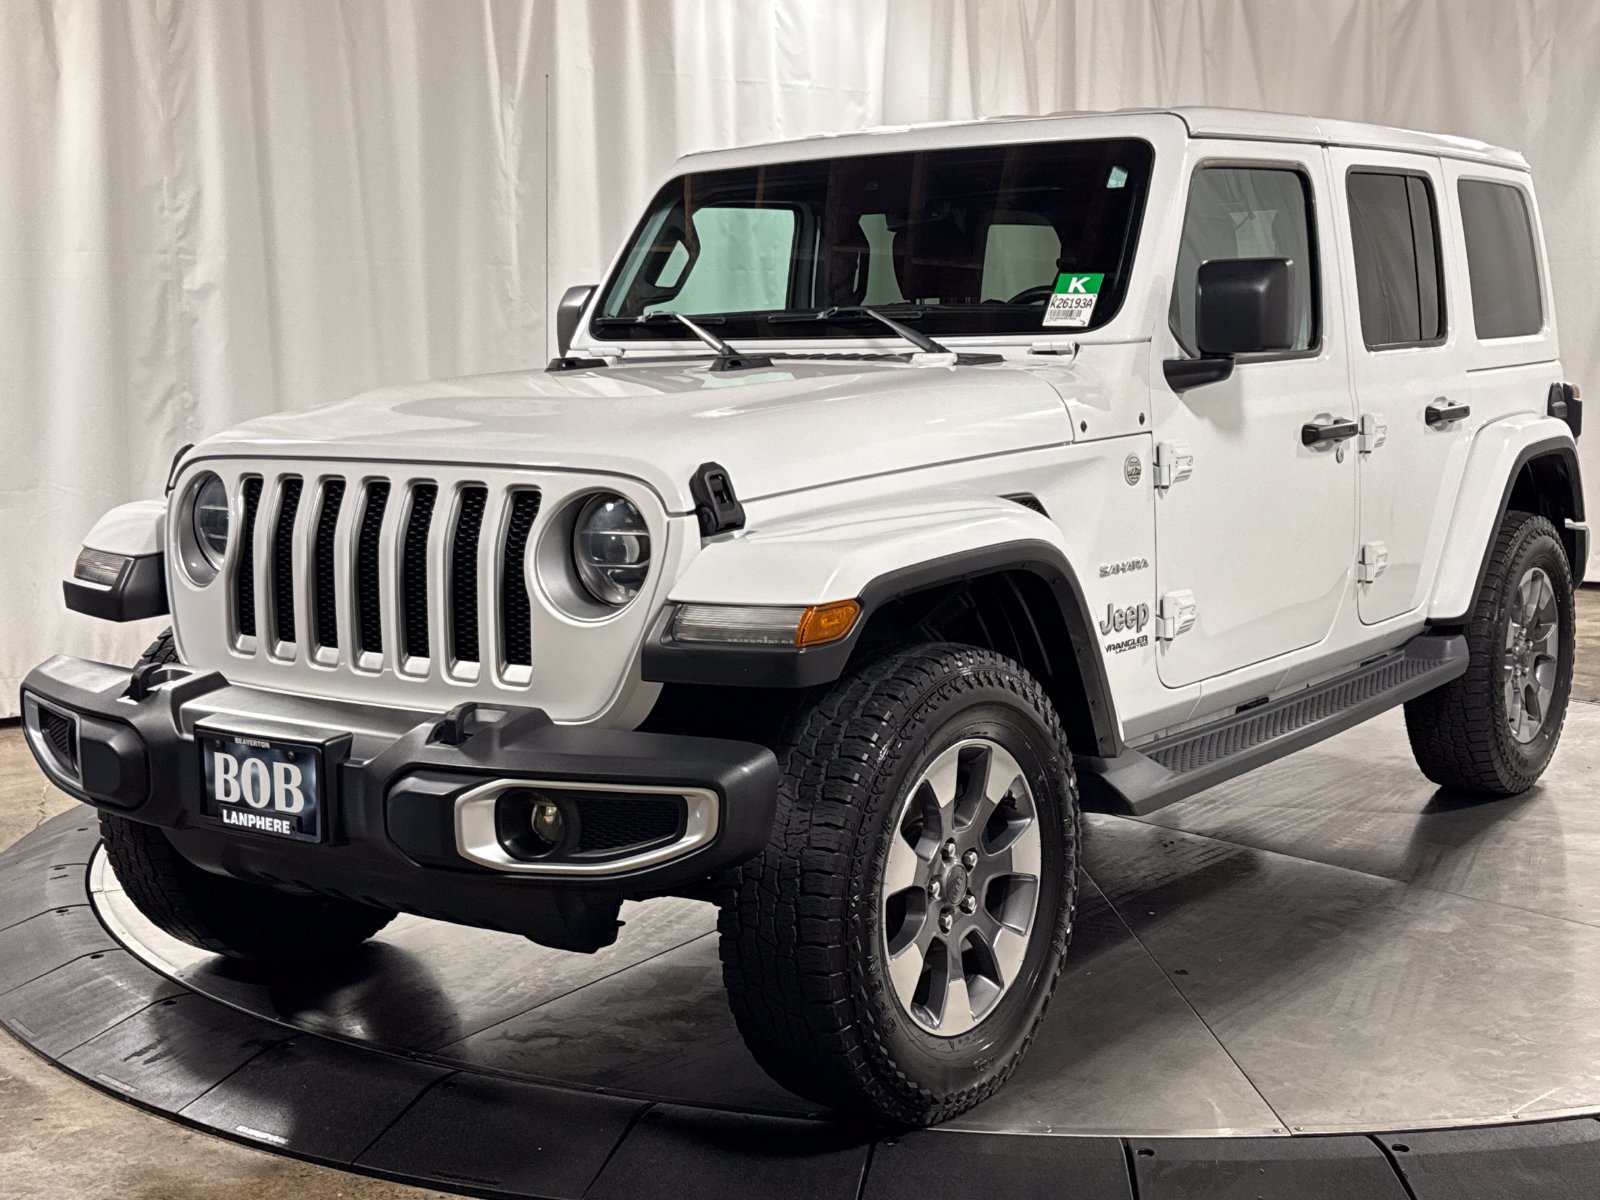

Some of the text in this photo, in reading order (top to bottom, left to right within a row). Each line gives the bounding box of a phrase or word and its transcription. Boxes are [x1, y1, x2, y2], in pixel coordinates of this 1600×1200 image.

[1067, 276, 1091, 293] K
[1049, 297, 1093, 309] K26193A
[1099, 558, 1149, 578] SAHARA
[1099, 602, 1150, 636] Jeep
[1104, 634, 1148, 653] WRANGLER
[234, 736, 271, 749] BEAVERTON
[213, 751, 305, 813] BOB
[222, 808, 291, 835] LANPHERE
